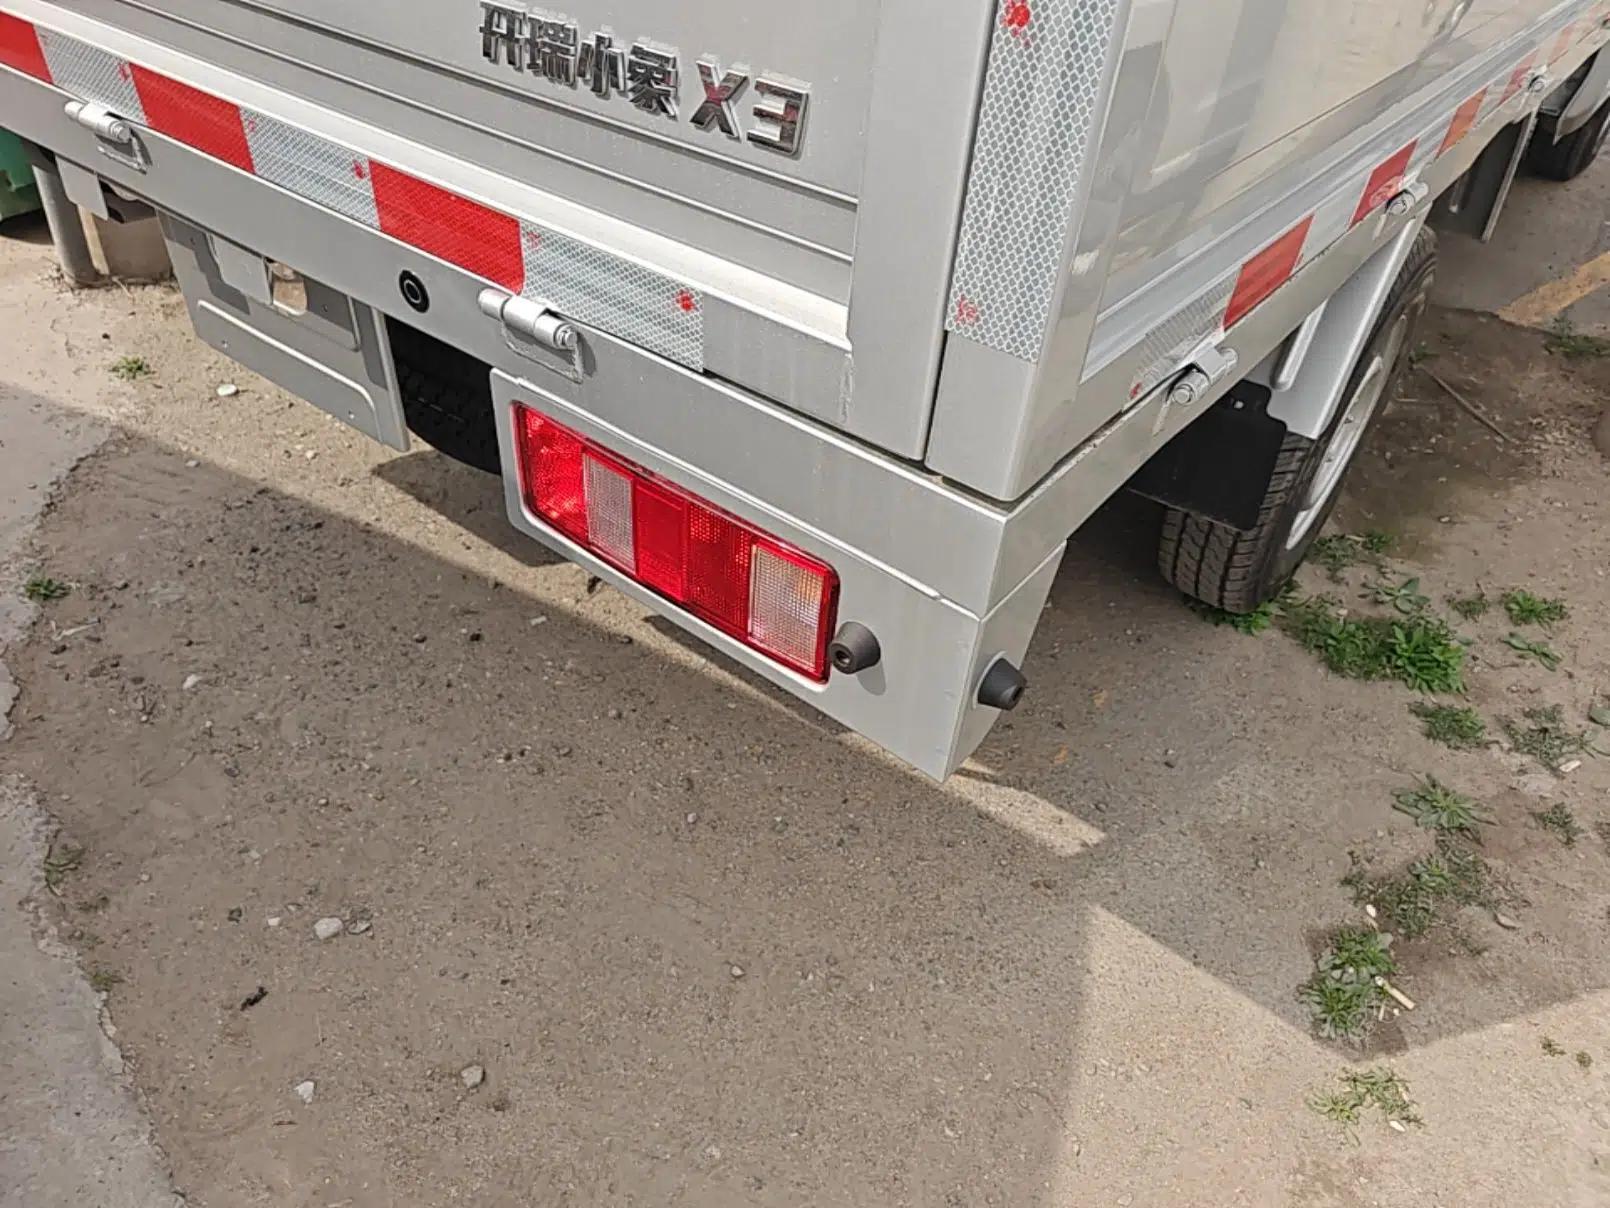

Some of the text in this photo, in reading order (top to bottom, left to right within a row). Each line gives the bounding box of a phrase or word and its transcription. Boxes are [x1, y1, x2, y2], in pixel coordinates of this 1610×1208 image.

[479, 0, 811, 158] 开瑞小象 X3
